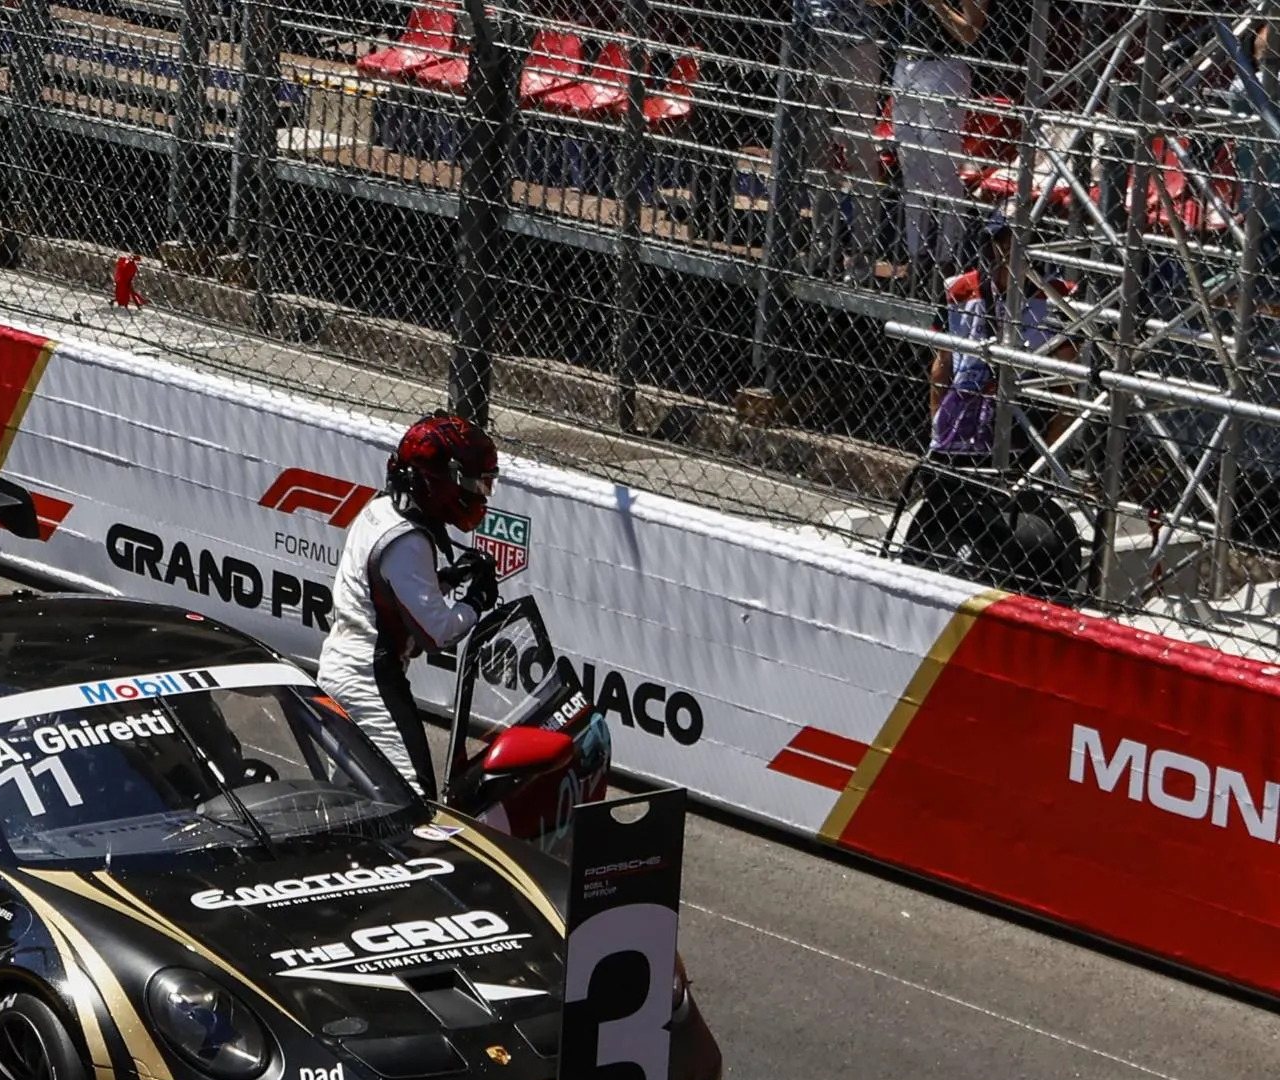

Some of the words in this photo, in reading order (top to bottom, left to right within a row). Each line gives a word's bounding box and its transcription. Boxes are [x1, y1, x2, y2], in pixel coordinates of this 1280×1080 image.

[484, 514, 525, 543] TAG
[106, 523, 264, 609] GRAND
[79, 673, 183, 704] Mobil
[188, 671, 210, 690] 1
[33, 709, 175, 755] Ghiretti
[584, 855, 662, 877] PORSCHE
[267, 901, 291, 909] FROM
[311, 893, 342, 902] RACING
[380, 883, 410, 891] RACING
[270, 942, 355, 967] THE
[351, 910, 510, 952] GRID
[354, 952, 433, 973] ULTIMATE
[432, 949, 461, 960] SIM
[466, 939, 522, 957] LEAGUE
